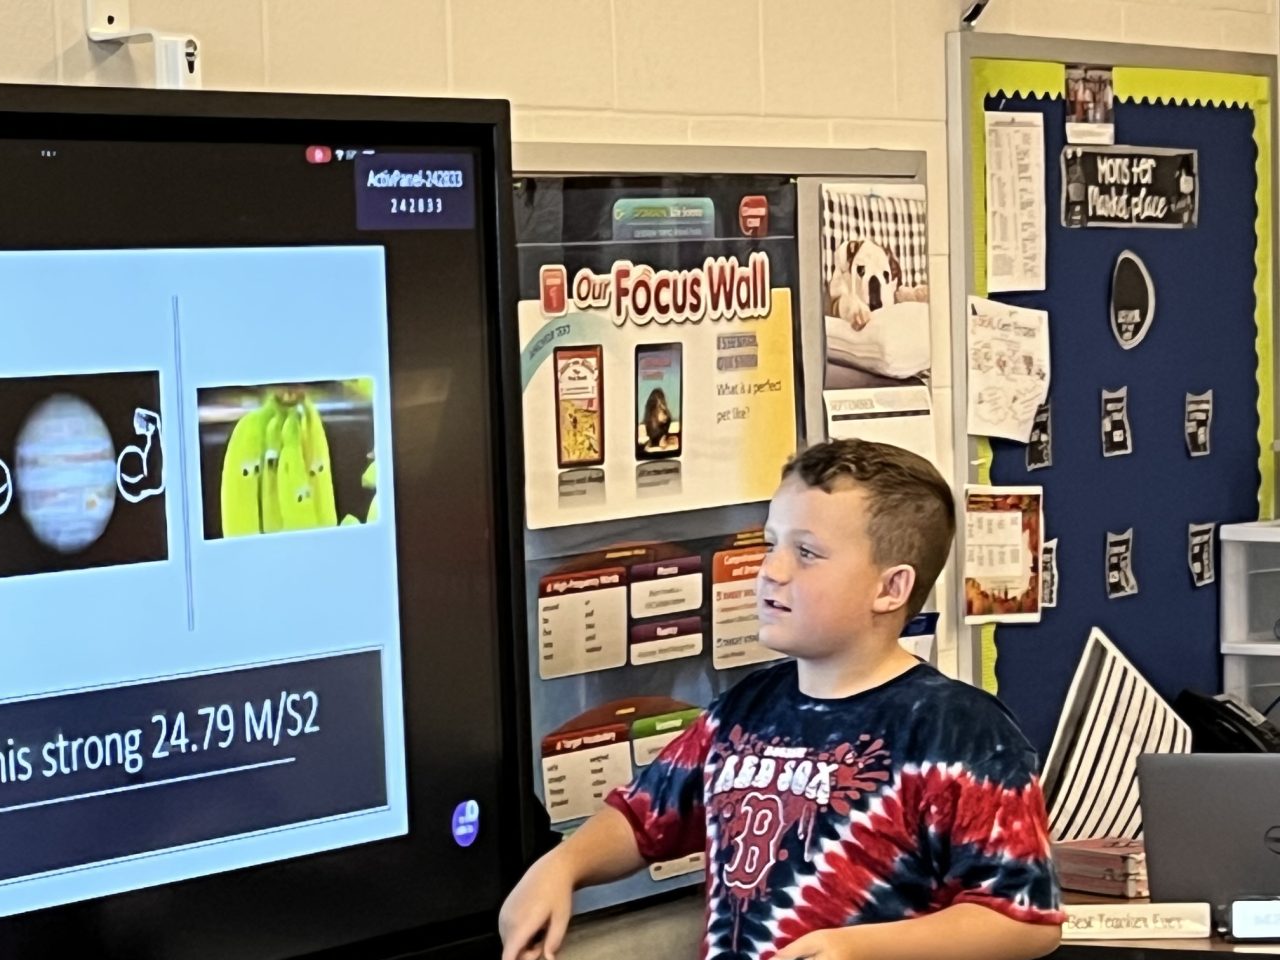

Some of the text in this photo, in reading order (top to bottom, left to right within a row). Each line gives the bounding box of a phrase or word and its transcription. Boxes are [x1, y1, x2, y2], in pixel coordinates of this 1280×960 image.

[576, 275, 612, 302] Our
[707, 256, 768, 313] Wall
[42, 728, 143, 774] strong
[151, 703, 235, 759] 24.79
[244, 690, 320, 747] M/S2
